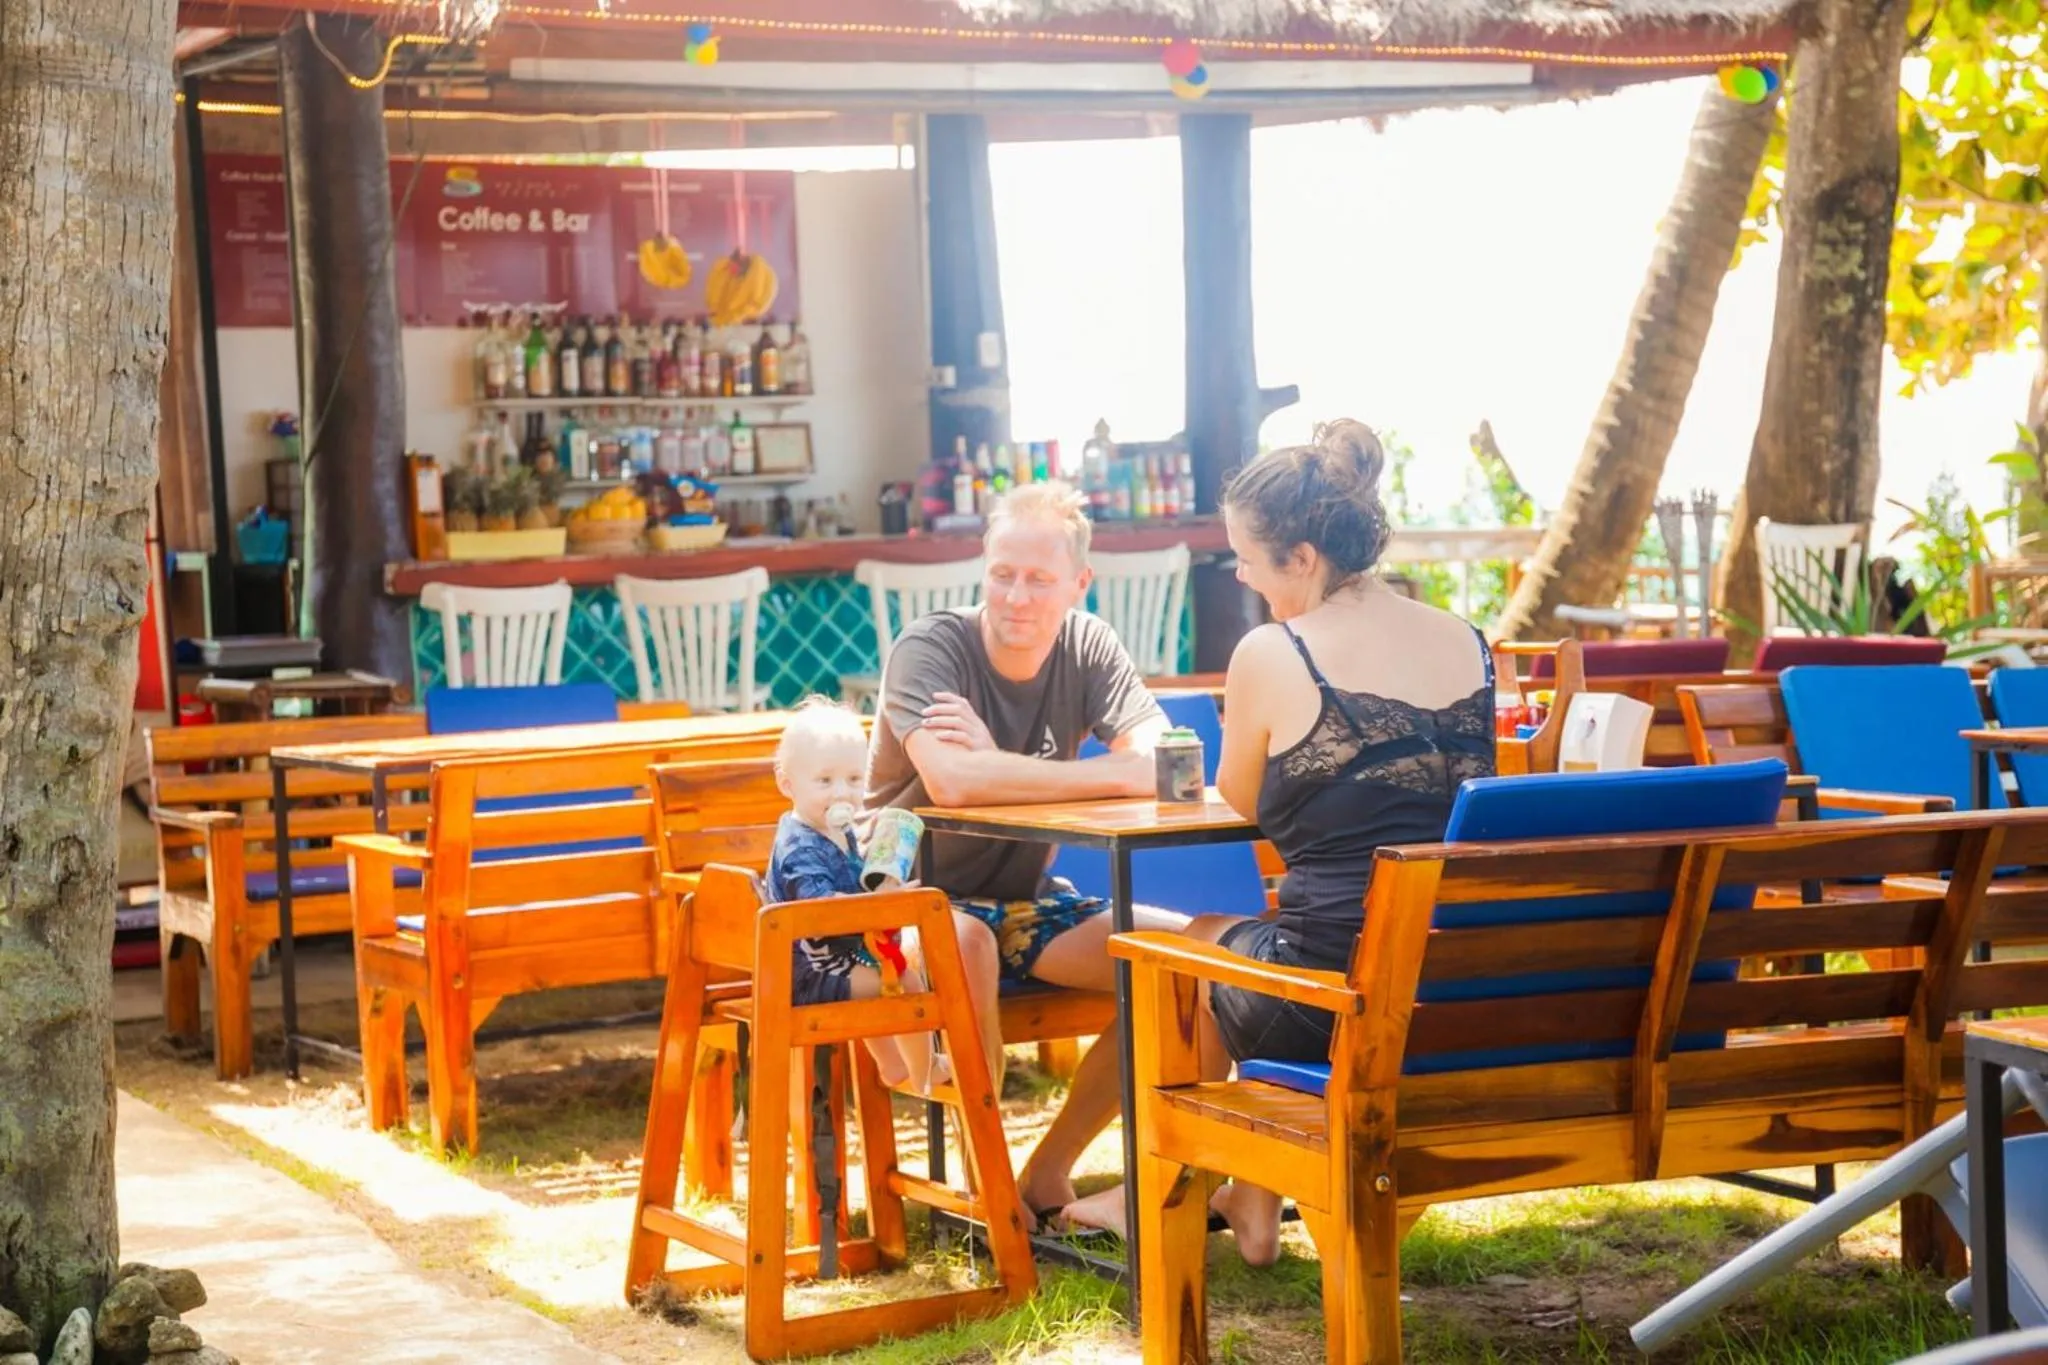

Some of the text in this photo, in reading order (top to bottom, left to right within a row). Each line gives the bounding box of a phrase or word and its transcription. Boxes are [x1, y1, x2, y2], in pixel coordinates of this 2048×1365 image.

[438, 206, 590, 232] Coffee & Bar
